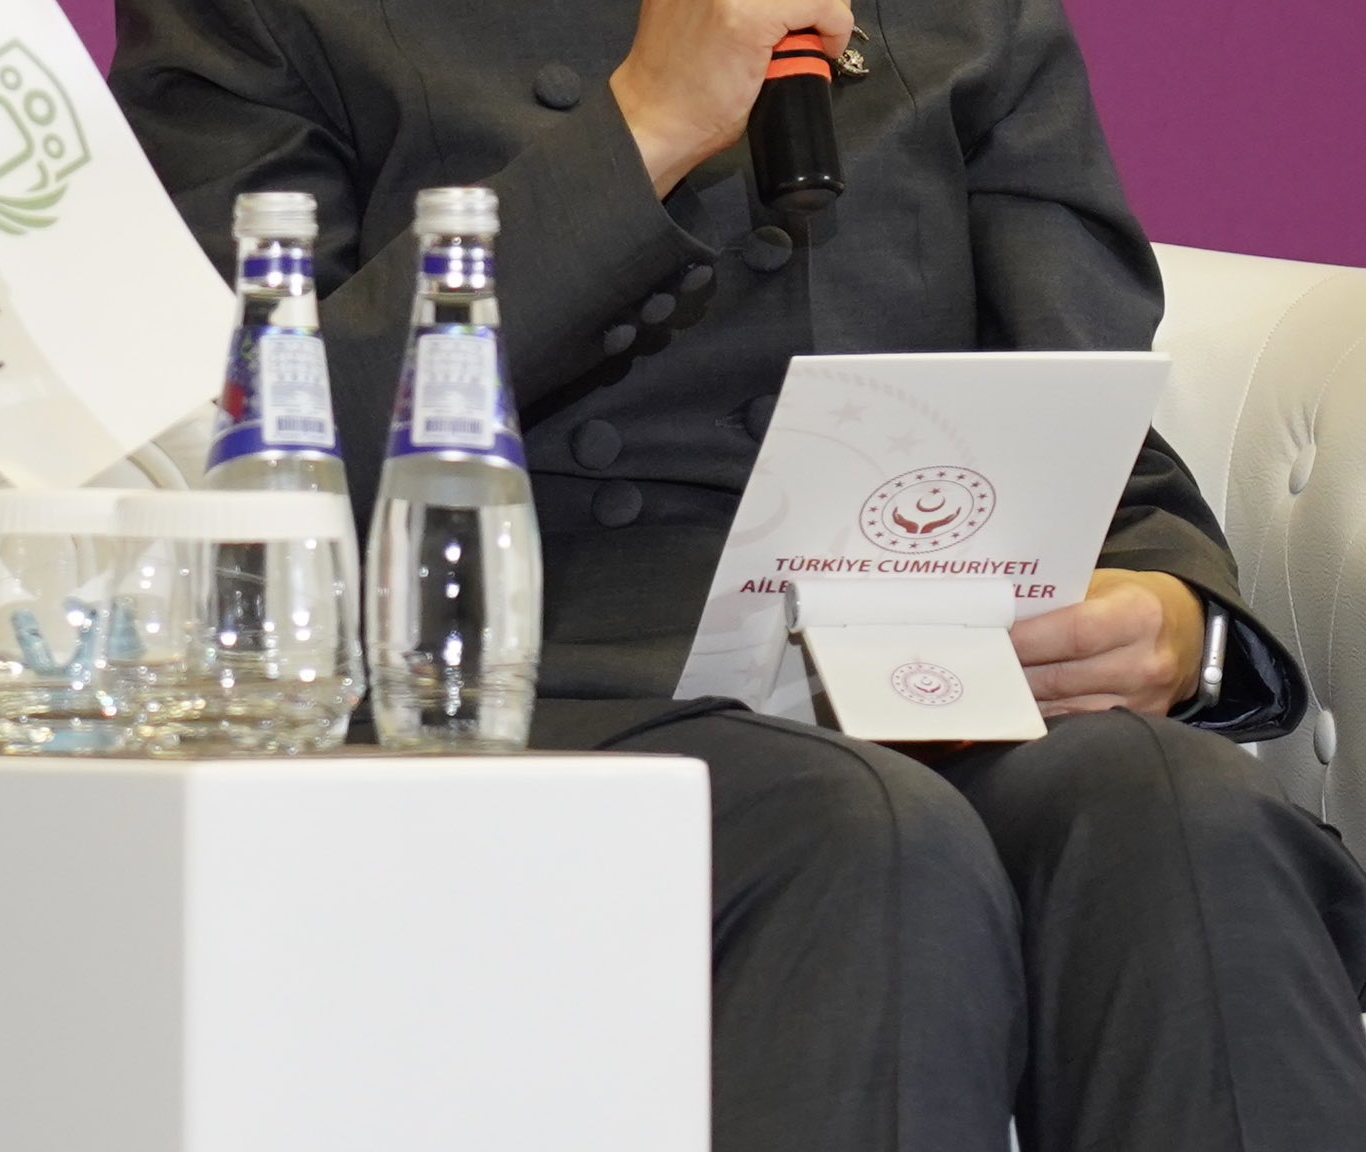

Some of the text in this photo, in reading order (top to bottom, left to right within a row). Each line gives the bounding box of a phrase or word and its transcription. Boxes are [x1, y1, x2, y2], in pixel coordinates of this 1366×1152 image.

[775, 555, 1041, 576] TÜRKİYE CUMHURİYETİ
[1012, 583, 1056, 599] LER
